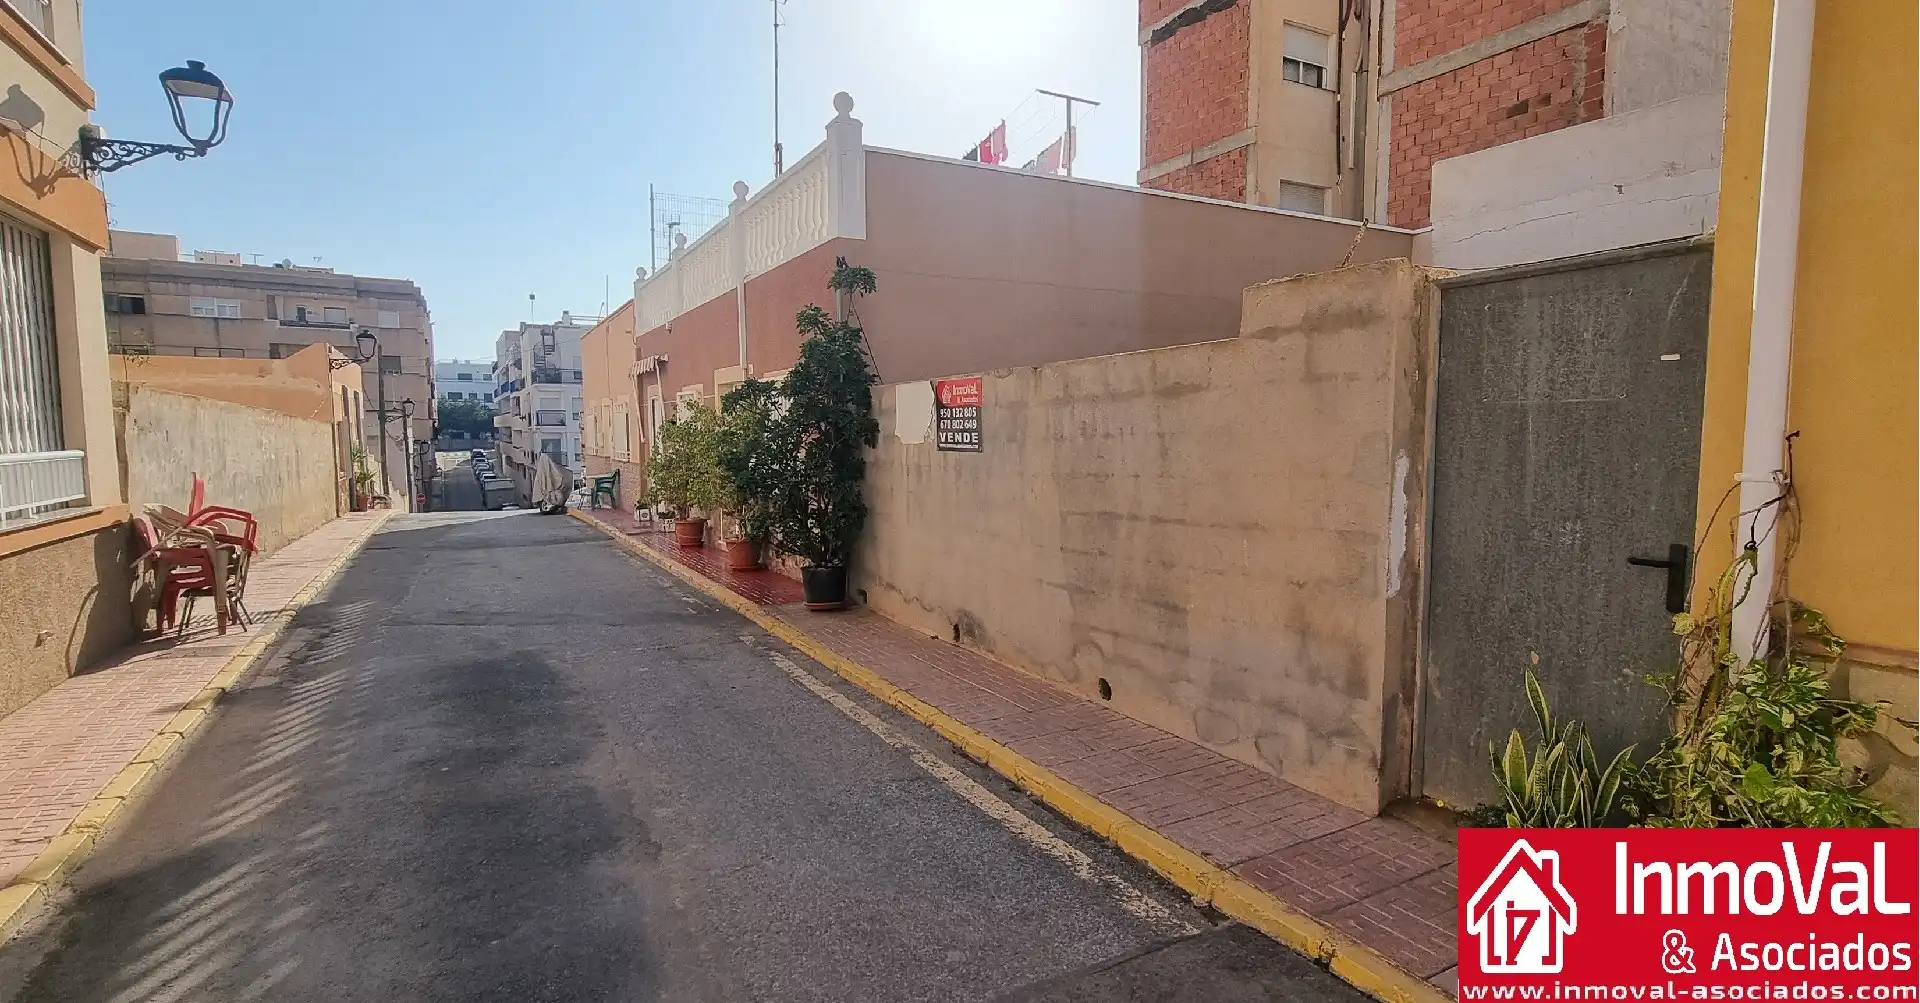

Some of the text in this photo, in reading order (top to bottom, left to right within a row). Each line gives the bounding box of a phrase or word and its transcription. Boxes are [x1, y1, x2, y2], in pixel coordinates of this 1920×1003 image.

[940, 409, 951, 417] 950
[952, 408, 963, 417] 132
[940, 432, 979, 443] VENDE
